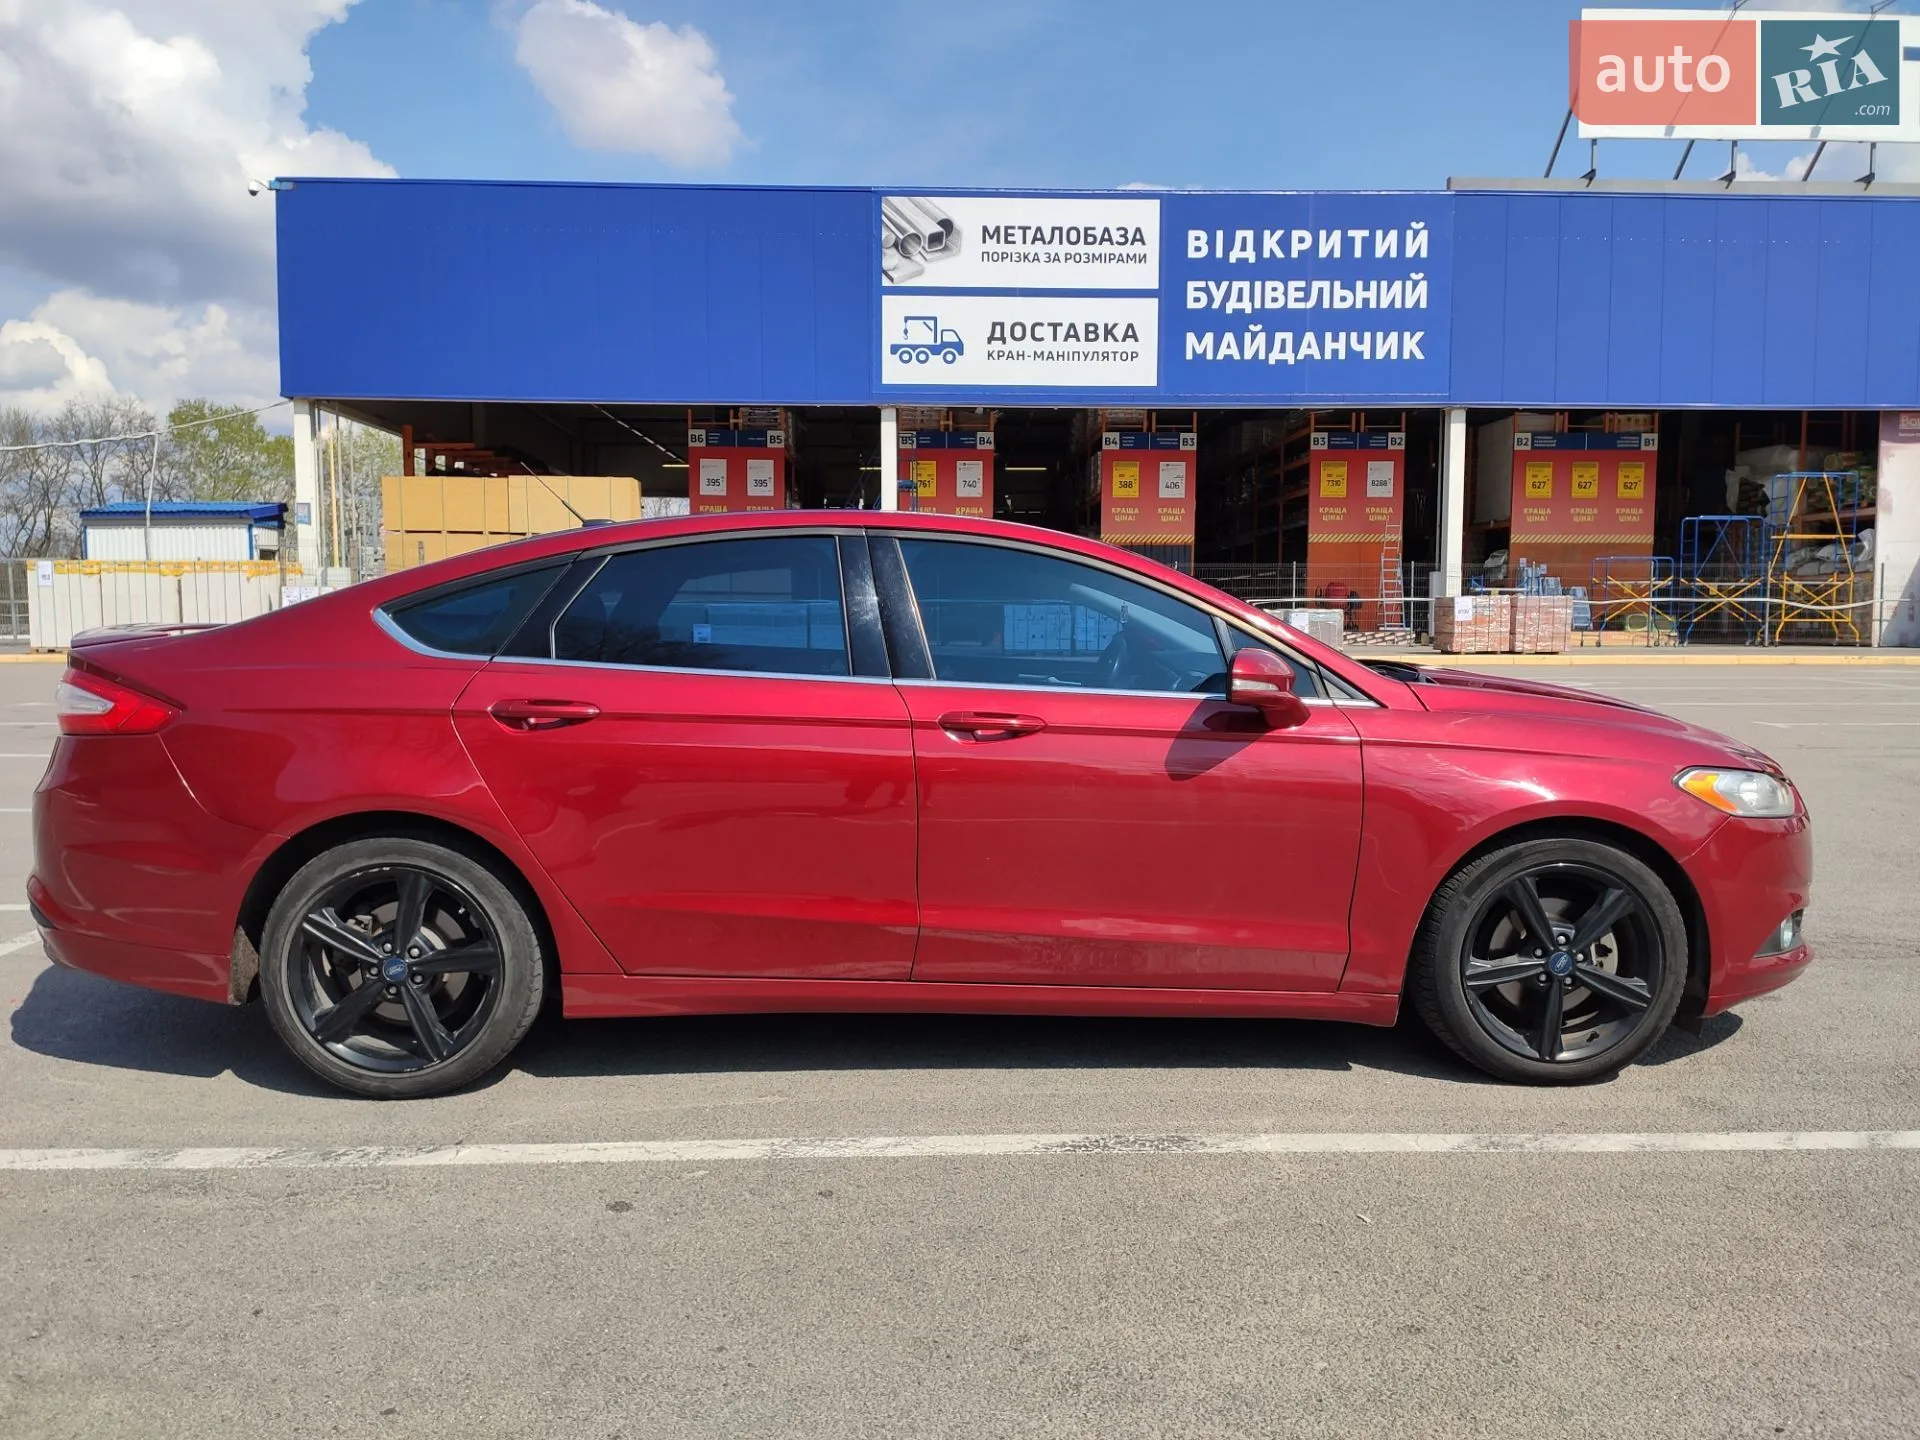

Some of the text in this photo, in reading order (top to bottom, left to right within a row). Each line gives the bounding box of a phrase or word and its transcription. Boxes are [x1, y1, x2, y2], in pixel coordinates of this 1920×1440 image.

[981, 225, 1147, 246] МЕТАЛОБАЗА
[1187, 221, 1428, 263] ВІДКРИТИЙ
[981, 251, 1147, 264] ПОРІЗКА ЗА РОЗМІРАМИ
[1186, 272, 1428, 314] БУДІВЕЛЬНИЙ
[987, 321, 1139, 345] ДОСТАВКА
[1185, 323, 1425, 365] МАЙДАНЧИК
[987, 350, 1139, 362] КРАН-МАНІПУЛЯТОР
[706, 478, 720, 487] 395
[753, 479, 768, 488] 395
[962, 480, 977, 488] 740
[1118, 480, 1133, 489] 388
[1164, 481, 1180, 490] 406
[1532, 481, 1546, 489] 627
[1578, 481, 1592, 490] 627
[1624, 482, 1638, 490] 627
